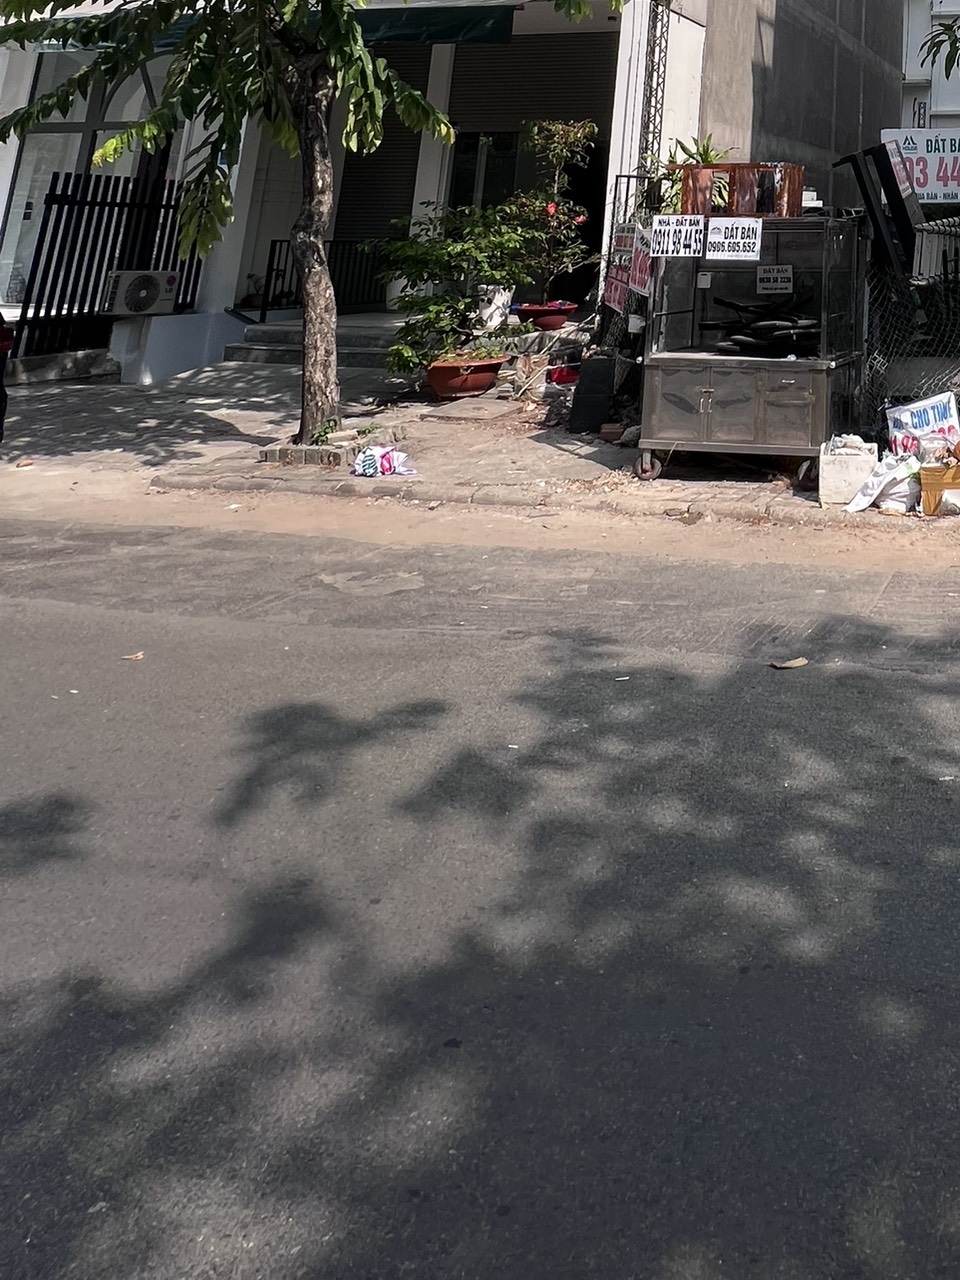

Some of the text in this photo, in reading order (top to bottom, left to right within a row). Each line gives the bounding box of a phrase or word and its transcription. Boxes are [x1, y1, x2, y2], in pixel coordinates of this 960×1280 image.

[925, 133, 947, 154] ĐẤT
[689, 216, 701, 227] BÁN
[740, 223, 758, 240] BÁN
[652, 229, 670, 255] 0911
[671, 229, 682, 255] 98
[683, 229, 692, 255] 44
[693, 229, 702, 255] 55
[910, 407, 930, 430] CHO
